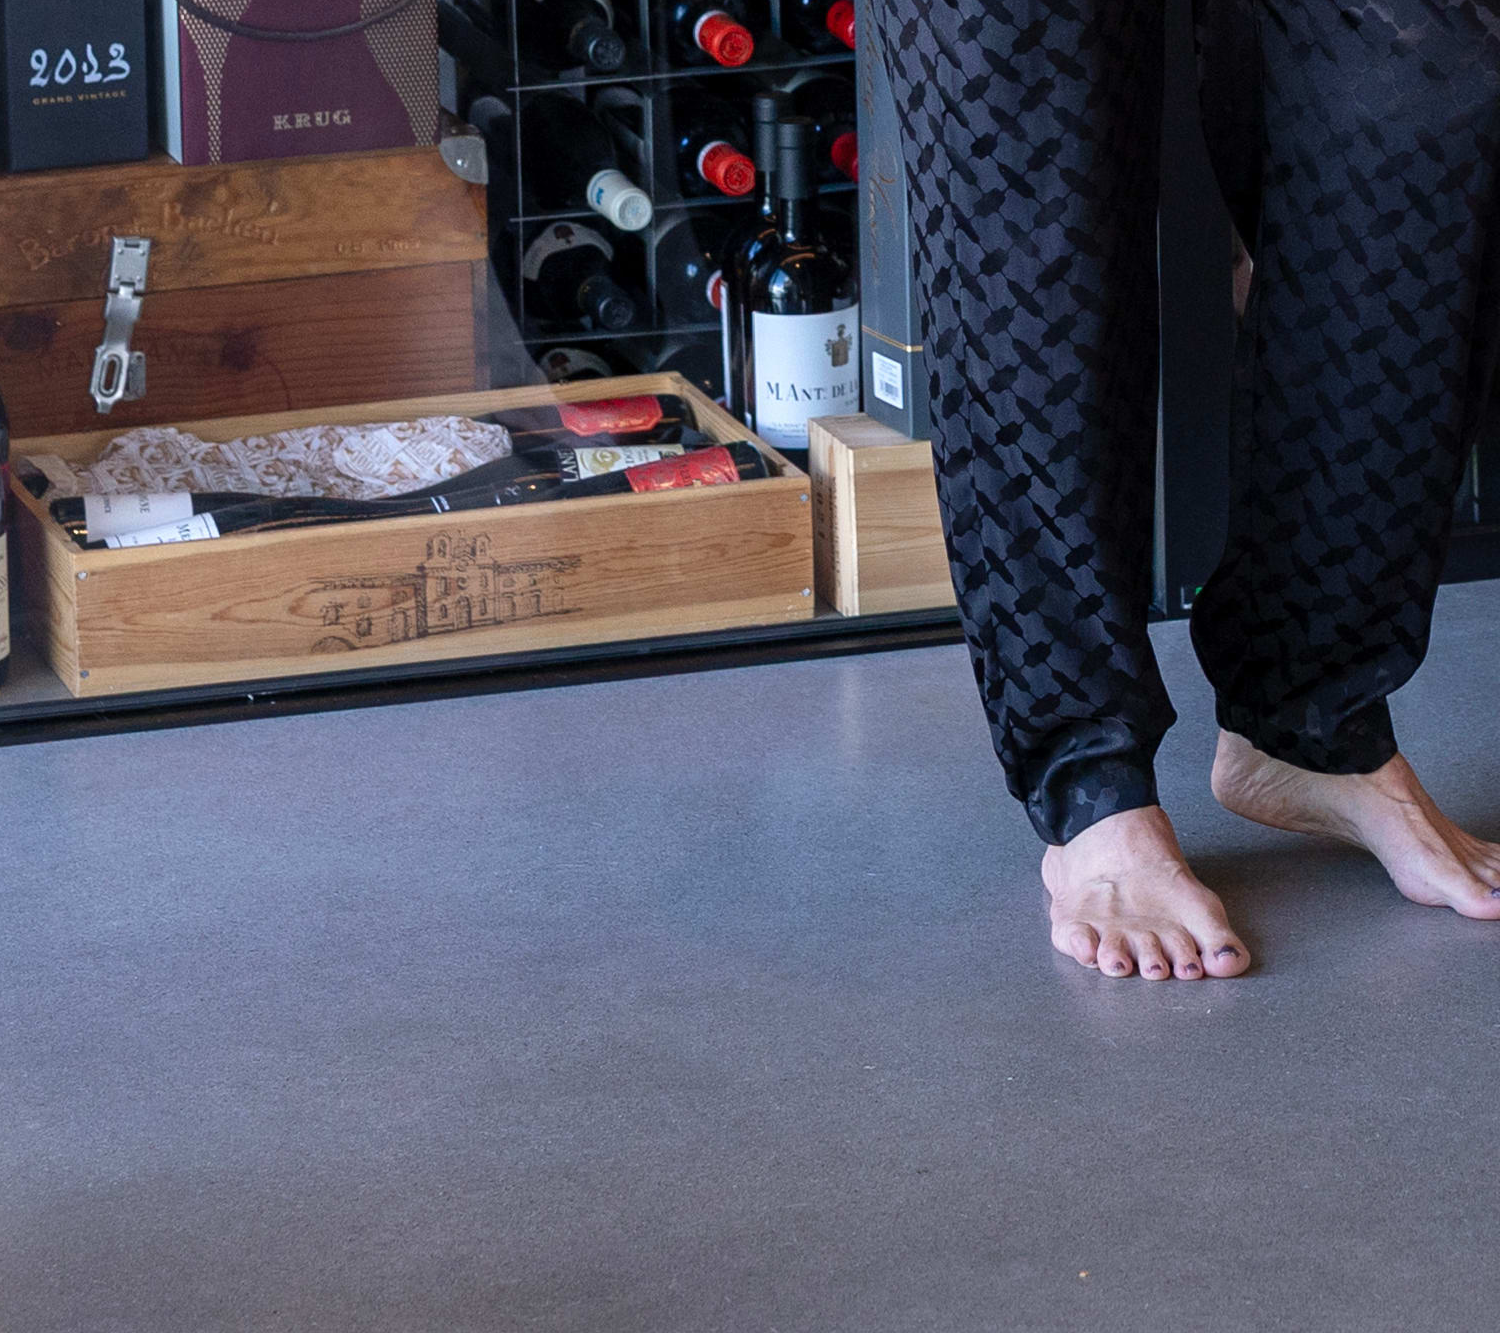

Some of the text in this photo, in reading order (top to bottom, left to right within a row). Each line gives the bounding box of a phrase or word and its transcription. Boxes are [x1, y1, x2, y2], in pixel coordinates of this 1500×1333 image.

[29, 42, 131, 87] 2013
[32, 90, 127, 106] GRAND VINTAGE
[272, 109, 352, 131] KRUG
